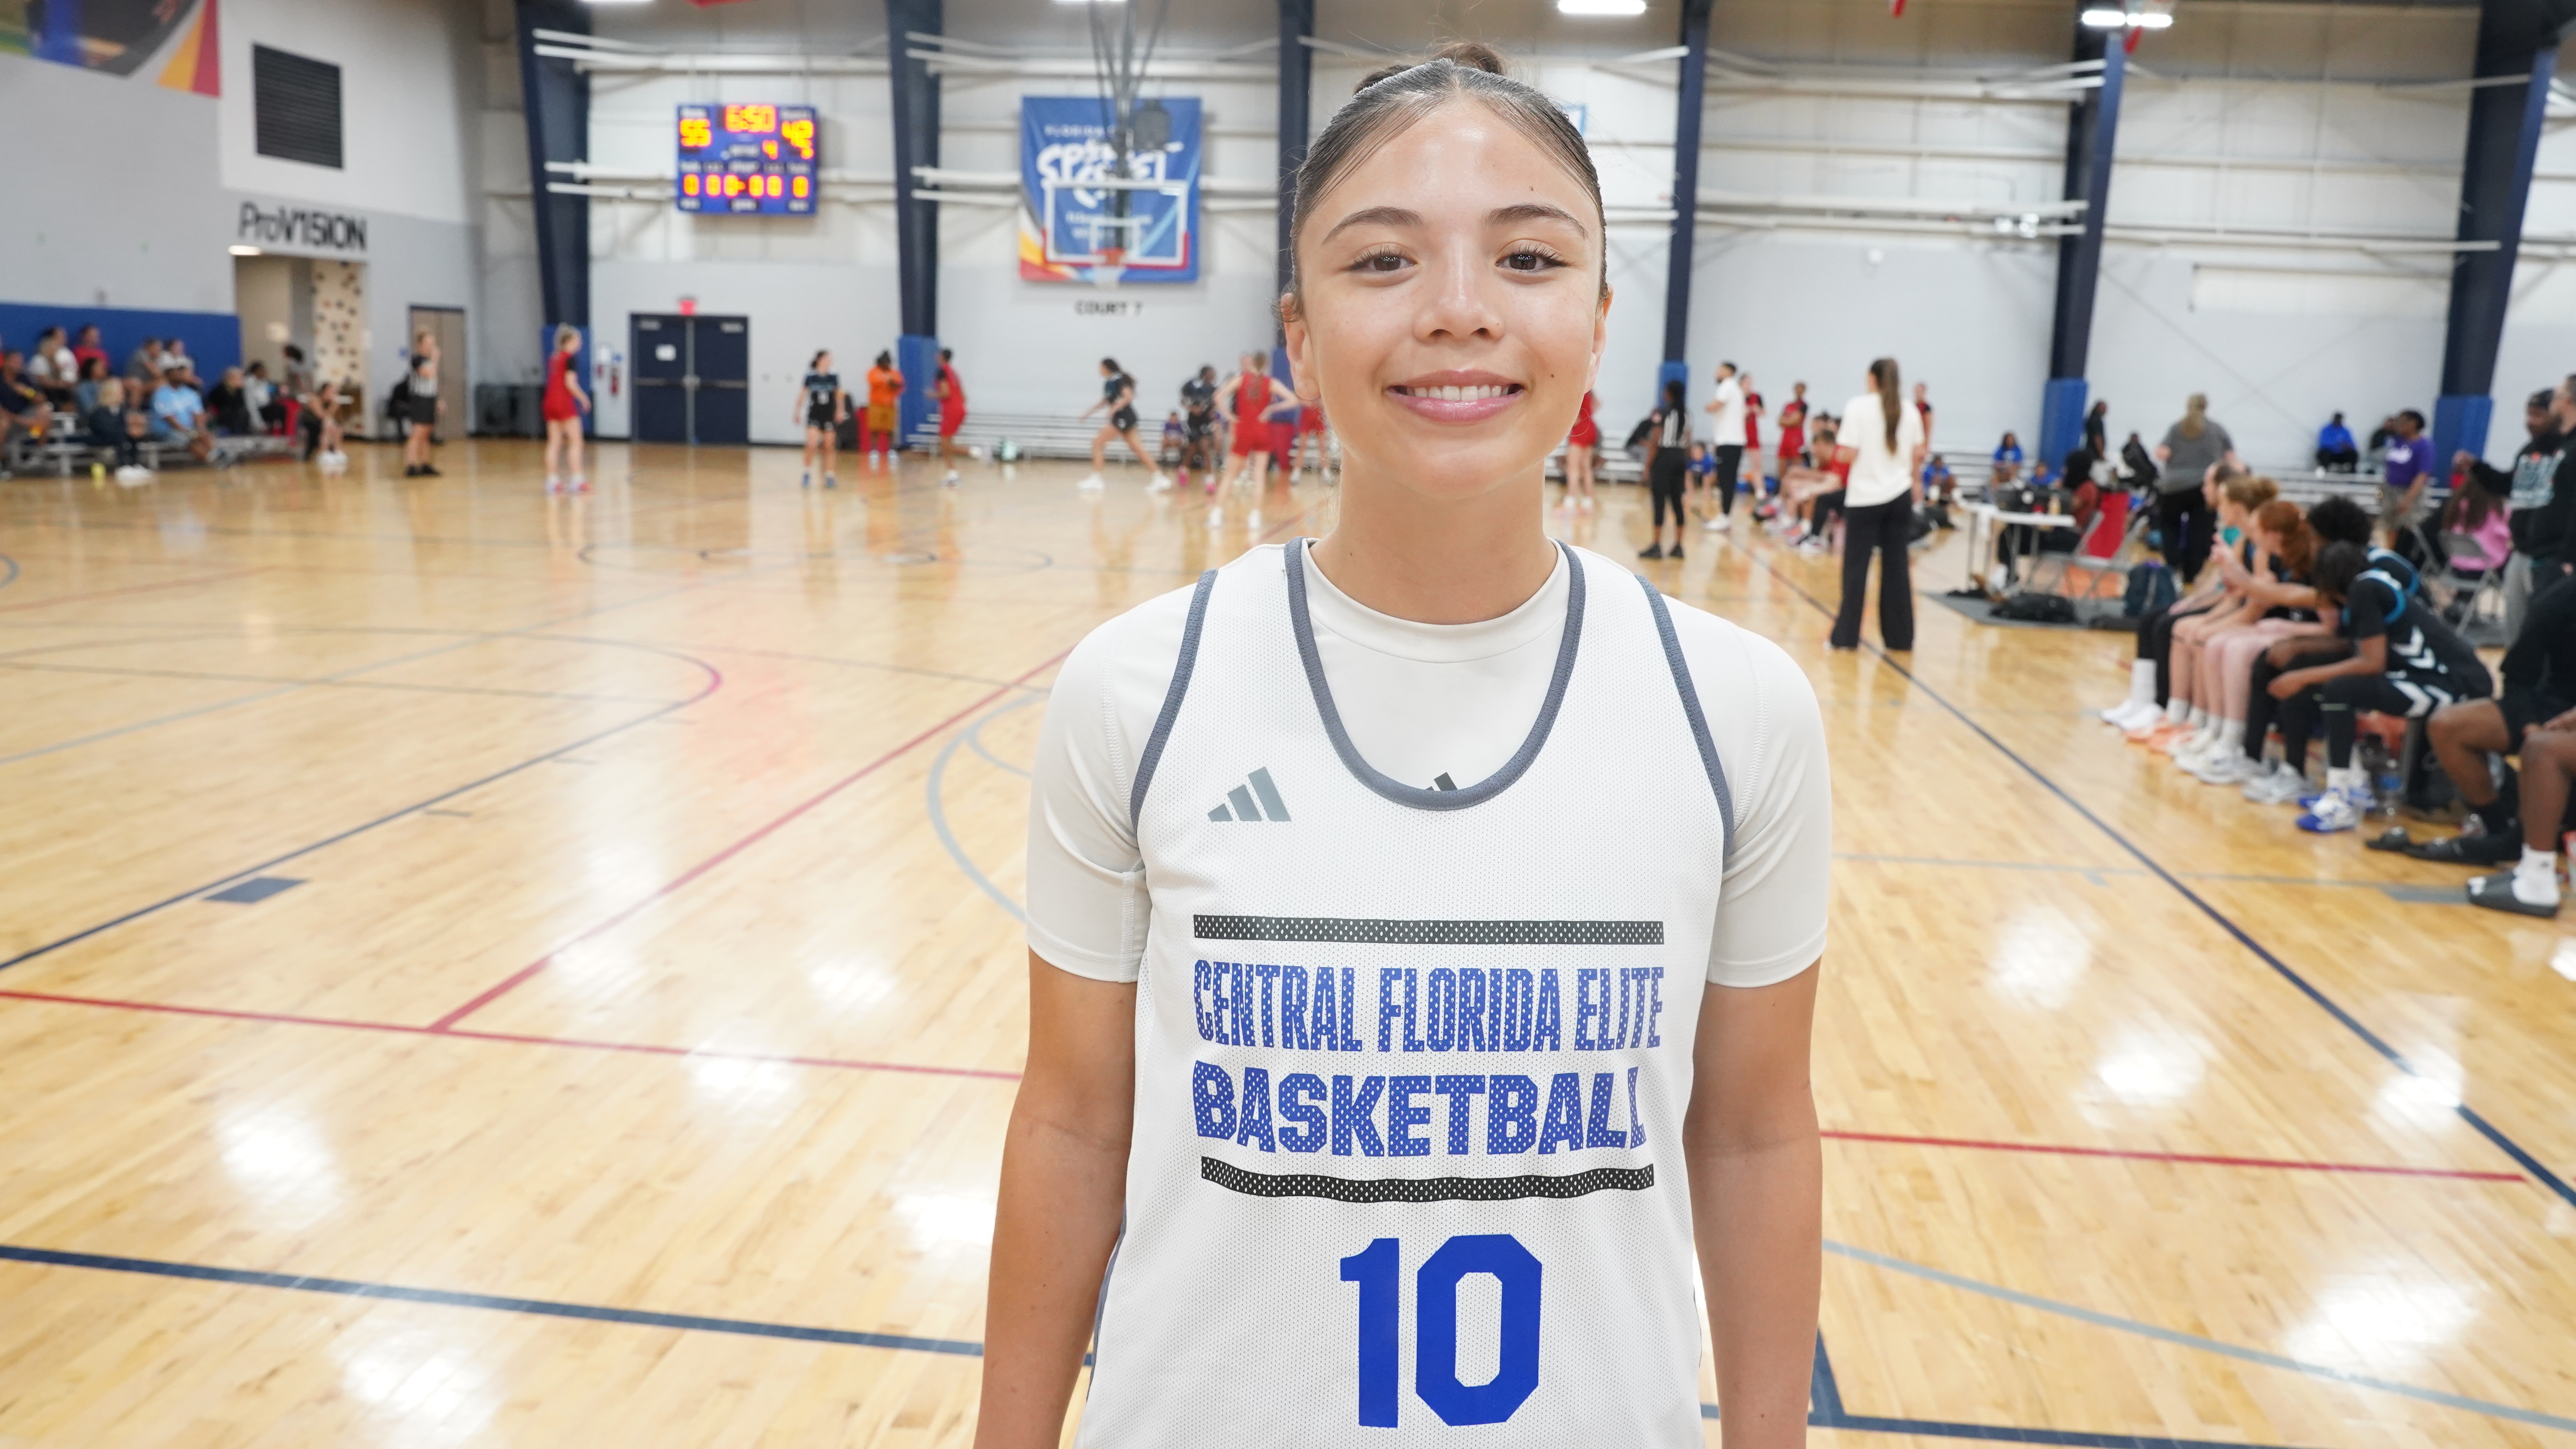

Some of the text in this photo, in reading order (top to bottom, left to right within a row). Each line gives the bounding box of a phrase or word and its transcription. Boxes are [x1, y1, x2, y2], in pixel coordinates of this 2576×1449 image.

[680, 118, 711, 146] 55
[1074, 300, 1127, 316] COURT
[1194, 960, 1665, 1052] CENTRAL FLORIDA ELITE
[1193, 1060, 1647, 1157] BASKETBALL
[1340, 1234, 1543, 1428] 10
